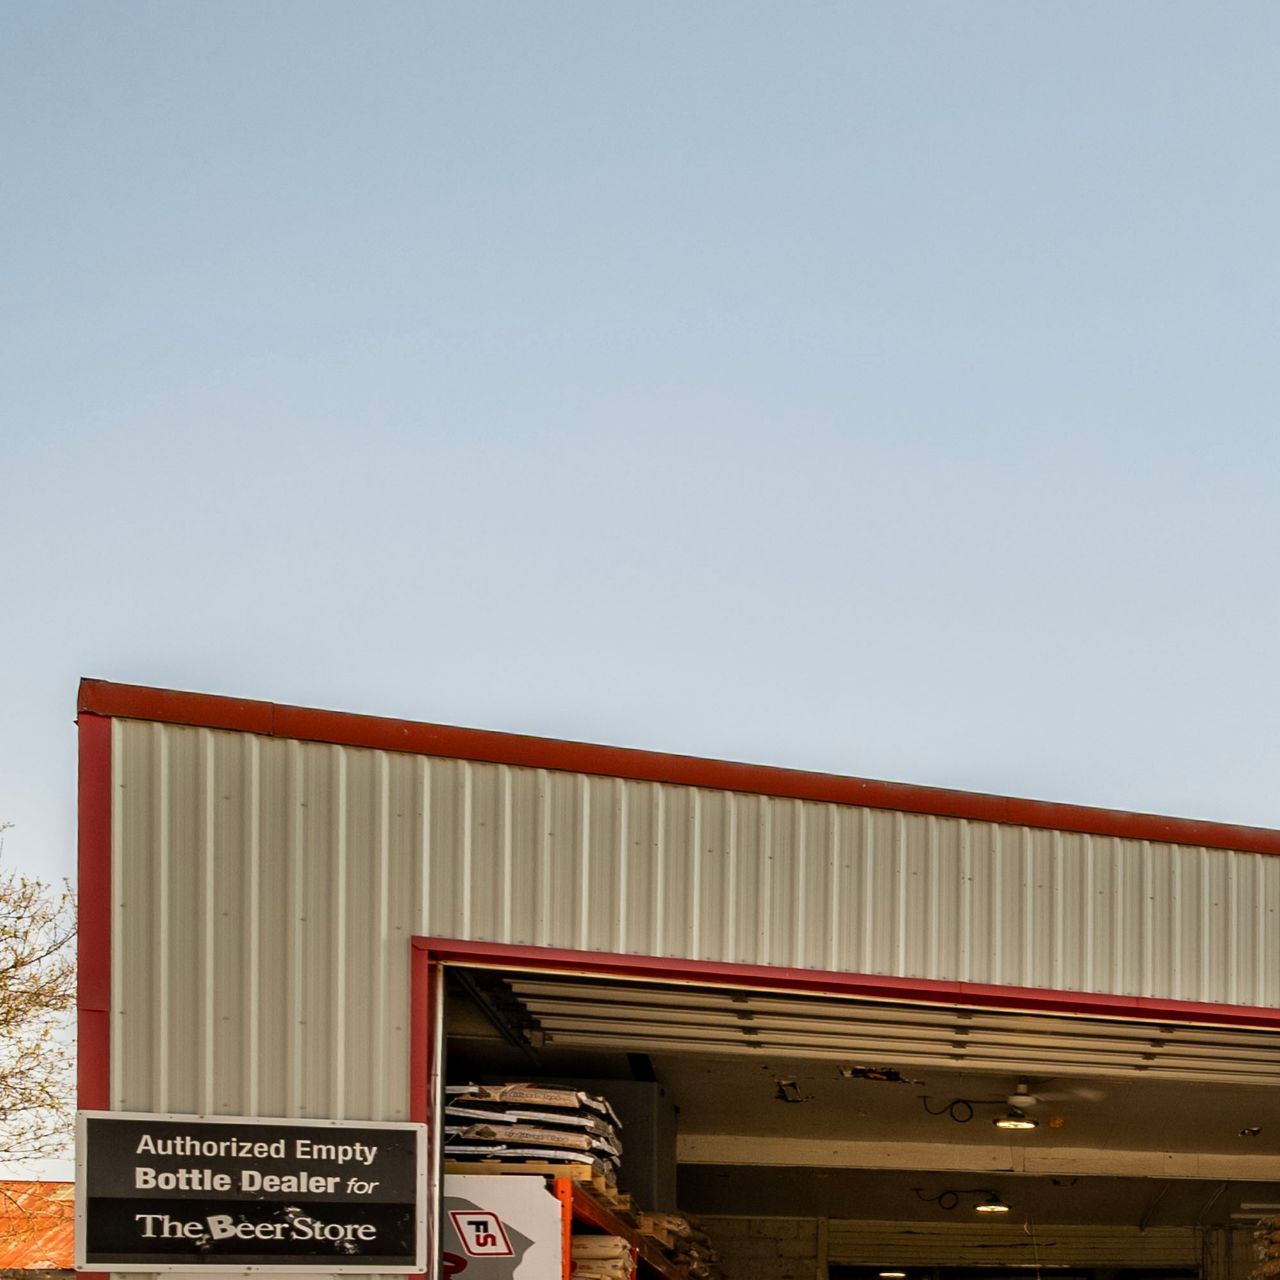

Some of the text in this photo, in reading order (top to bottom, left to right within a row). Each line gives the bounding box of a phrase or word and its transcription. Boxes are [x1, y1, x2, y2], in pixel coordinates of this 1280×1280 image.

[136, 1134, 377, 1164] Authorized Empty
[135, 1167, 379, 1195] Bottle Dealer for
[136, 1214, 376, 1241] The Beer Store
[467, 1220, 497, 1247] FS
